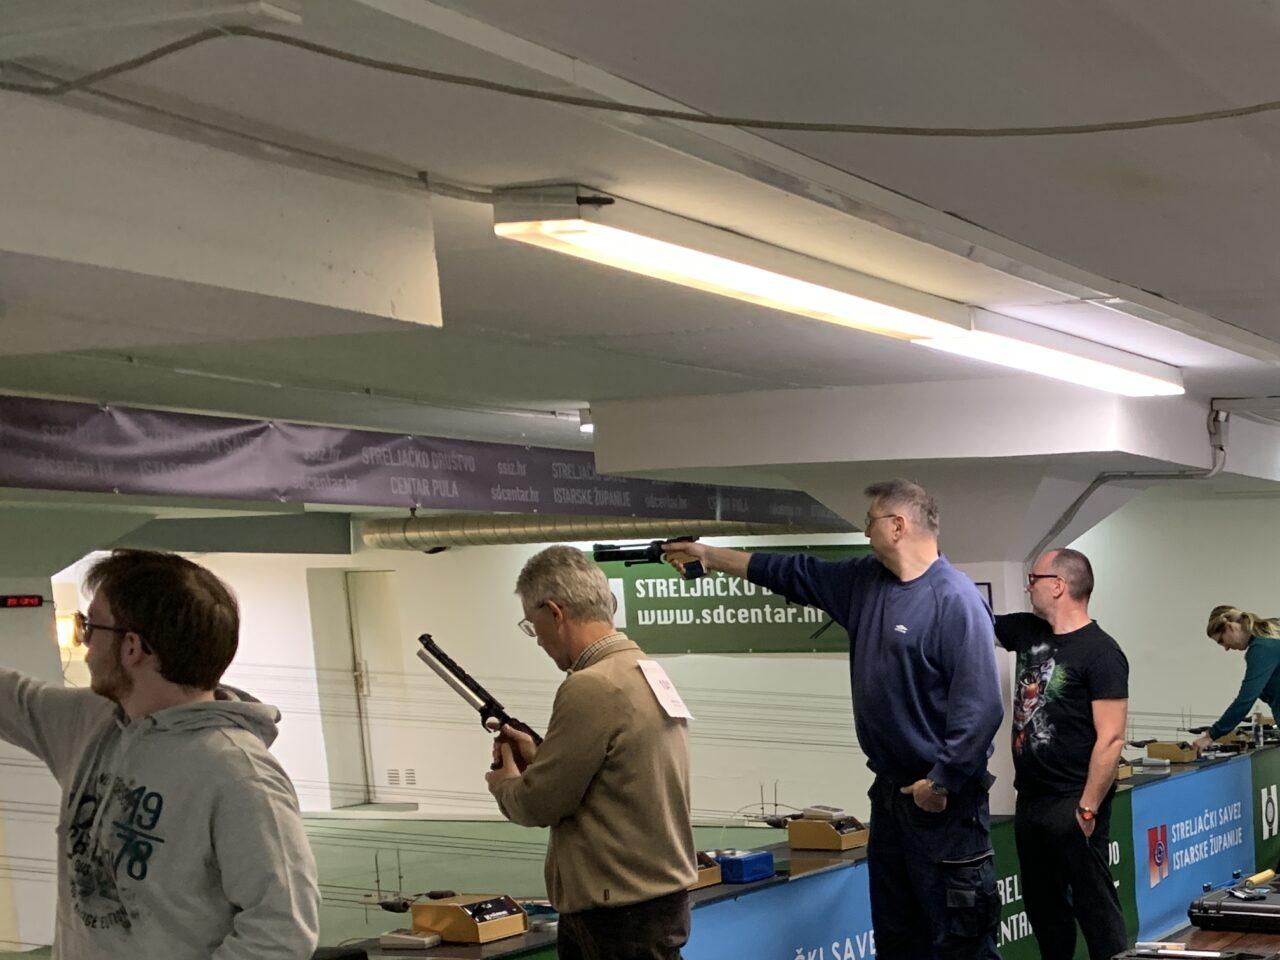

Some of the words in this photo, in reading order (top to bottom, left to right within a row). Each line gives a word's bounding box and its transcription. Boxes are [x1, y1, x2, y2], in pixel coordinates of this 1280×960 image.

[361, 446, 430, 469] STRELJAČKO
[432, 450, 477, 473] DRUŠTVO
[389, 476, 431, 496] CENTAR
[432, 478, 460, 498] PULA
[491, 484, 540, 503] sdcentar.hr
[553, 487, 593, 505] ISTARSKE
[637, 604, 825, 625] www.sdcentar.hr
[1171, 808, 1217, 843] STRELJAČKI
[1218, 801, 1242, 825] SAVEZ
[1173, 842, 1209, 871] ISTARSKE
[1209, 827, 1243, 855] ŽUPANIJE
